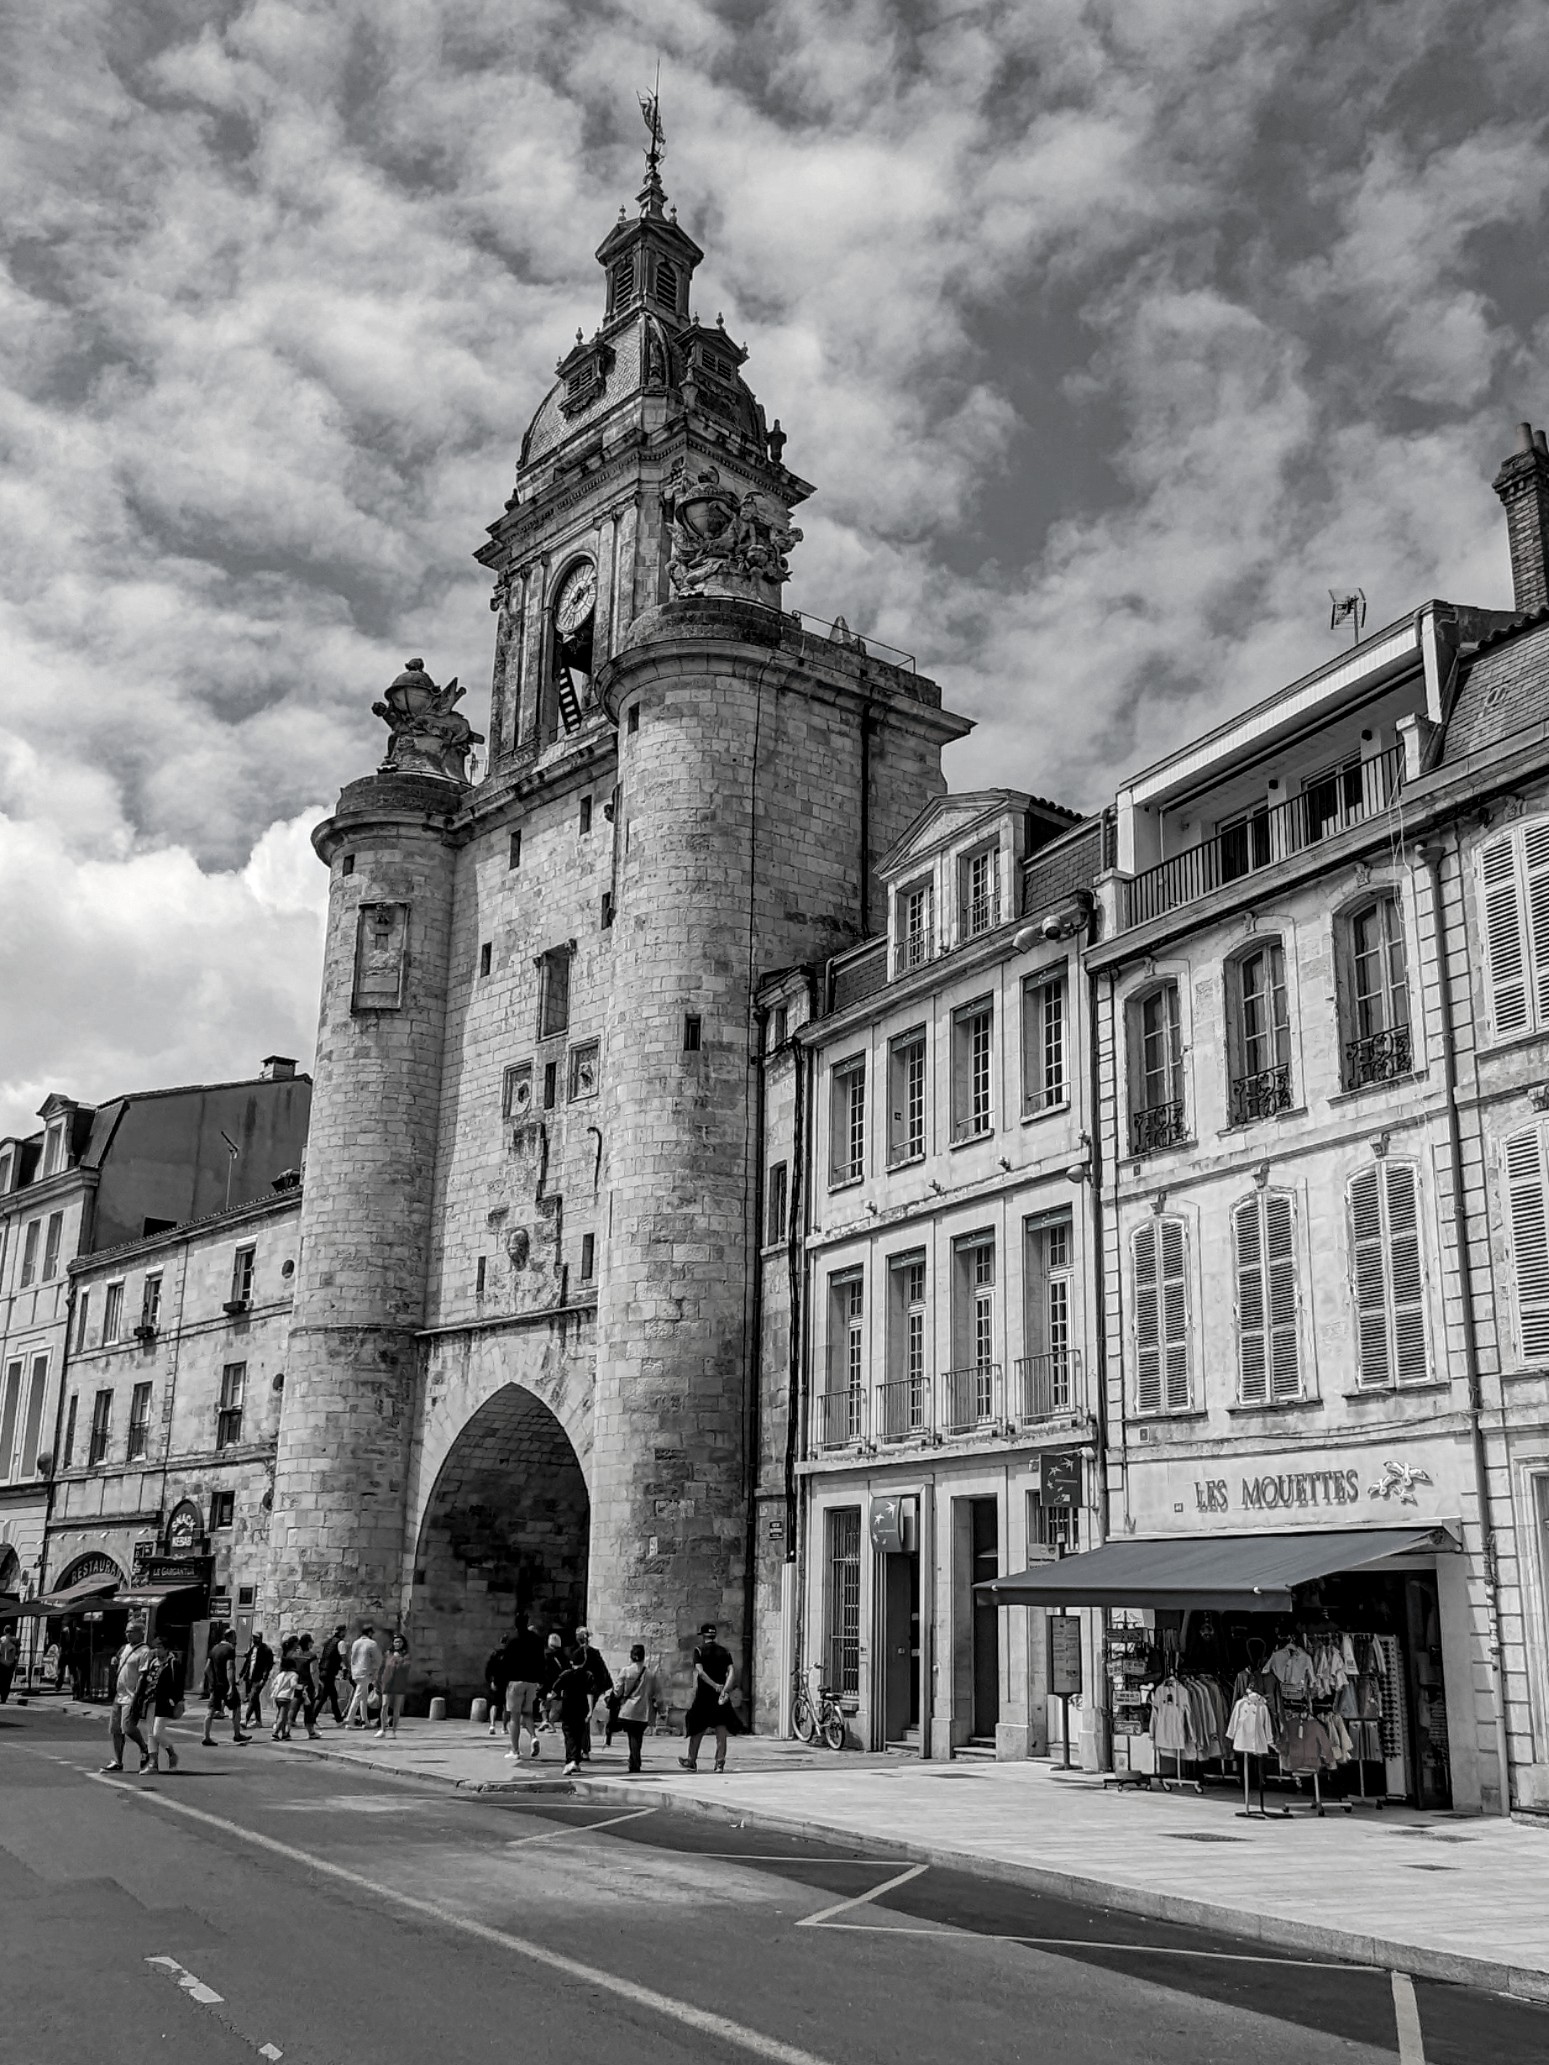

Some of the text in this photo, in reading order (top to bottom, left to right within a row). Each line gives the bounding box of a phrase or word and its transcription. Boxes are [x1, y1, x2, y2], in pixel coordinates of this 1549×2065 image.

[1194, 1470, 1359, 1511] LES MOUETTES
[171, 1513, 196, 1532] SNACK
[171, 1536, 193, 1548] KEBAB
[71, 1559, 122, 1584] RESTAURAN
